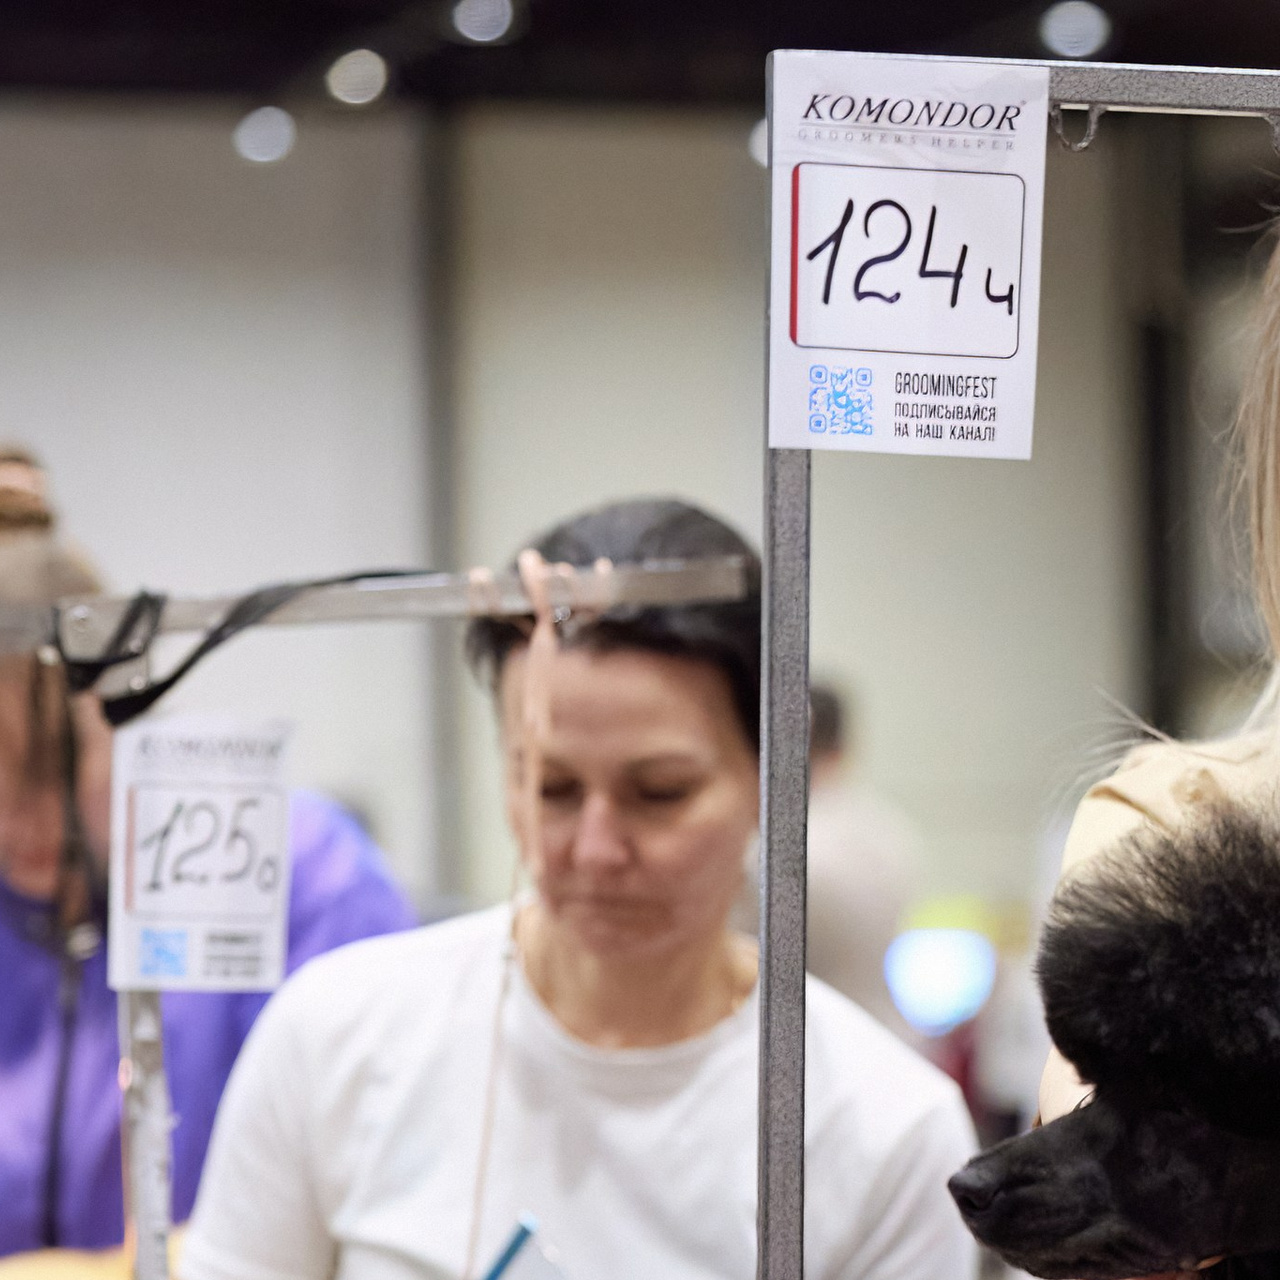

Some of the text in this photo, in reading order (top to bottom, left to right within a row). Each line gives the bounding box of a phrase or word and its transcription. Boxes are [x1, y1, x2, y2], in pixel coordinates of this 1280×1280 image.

[802, 93, 1021, 131] KOMONDOR
[894, 371, 997, 399] GROOMINGFEST
[894, 402, 997, 421] ПОДПИСЫВАЙСЯ
[894, 422, 910, 437] НА
[915, 423, 943, 439] НАШ
